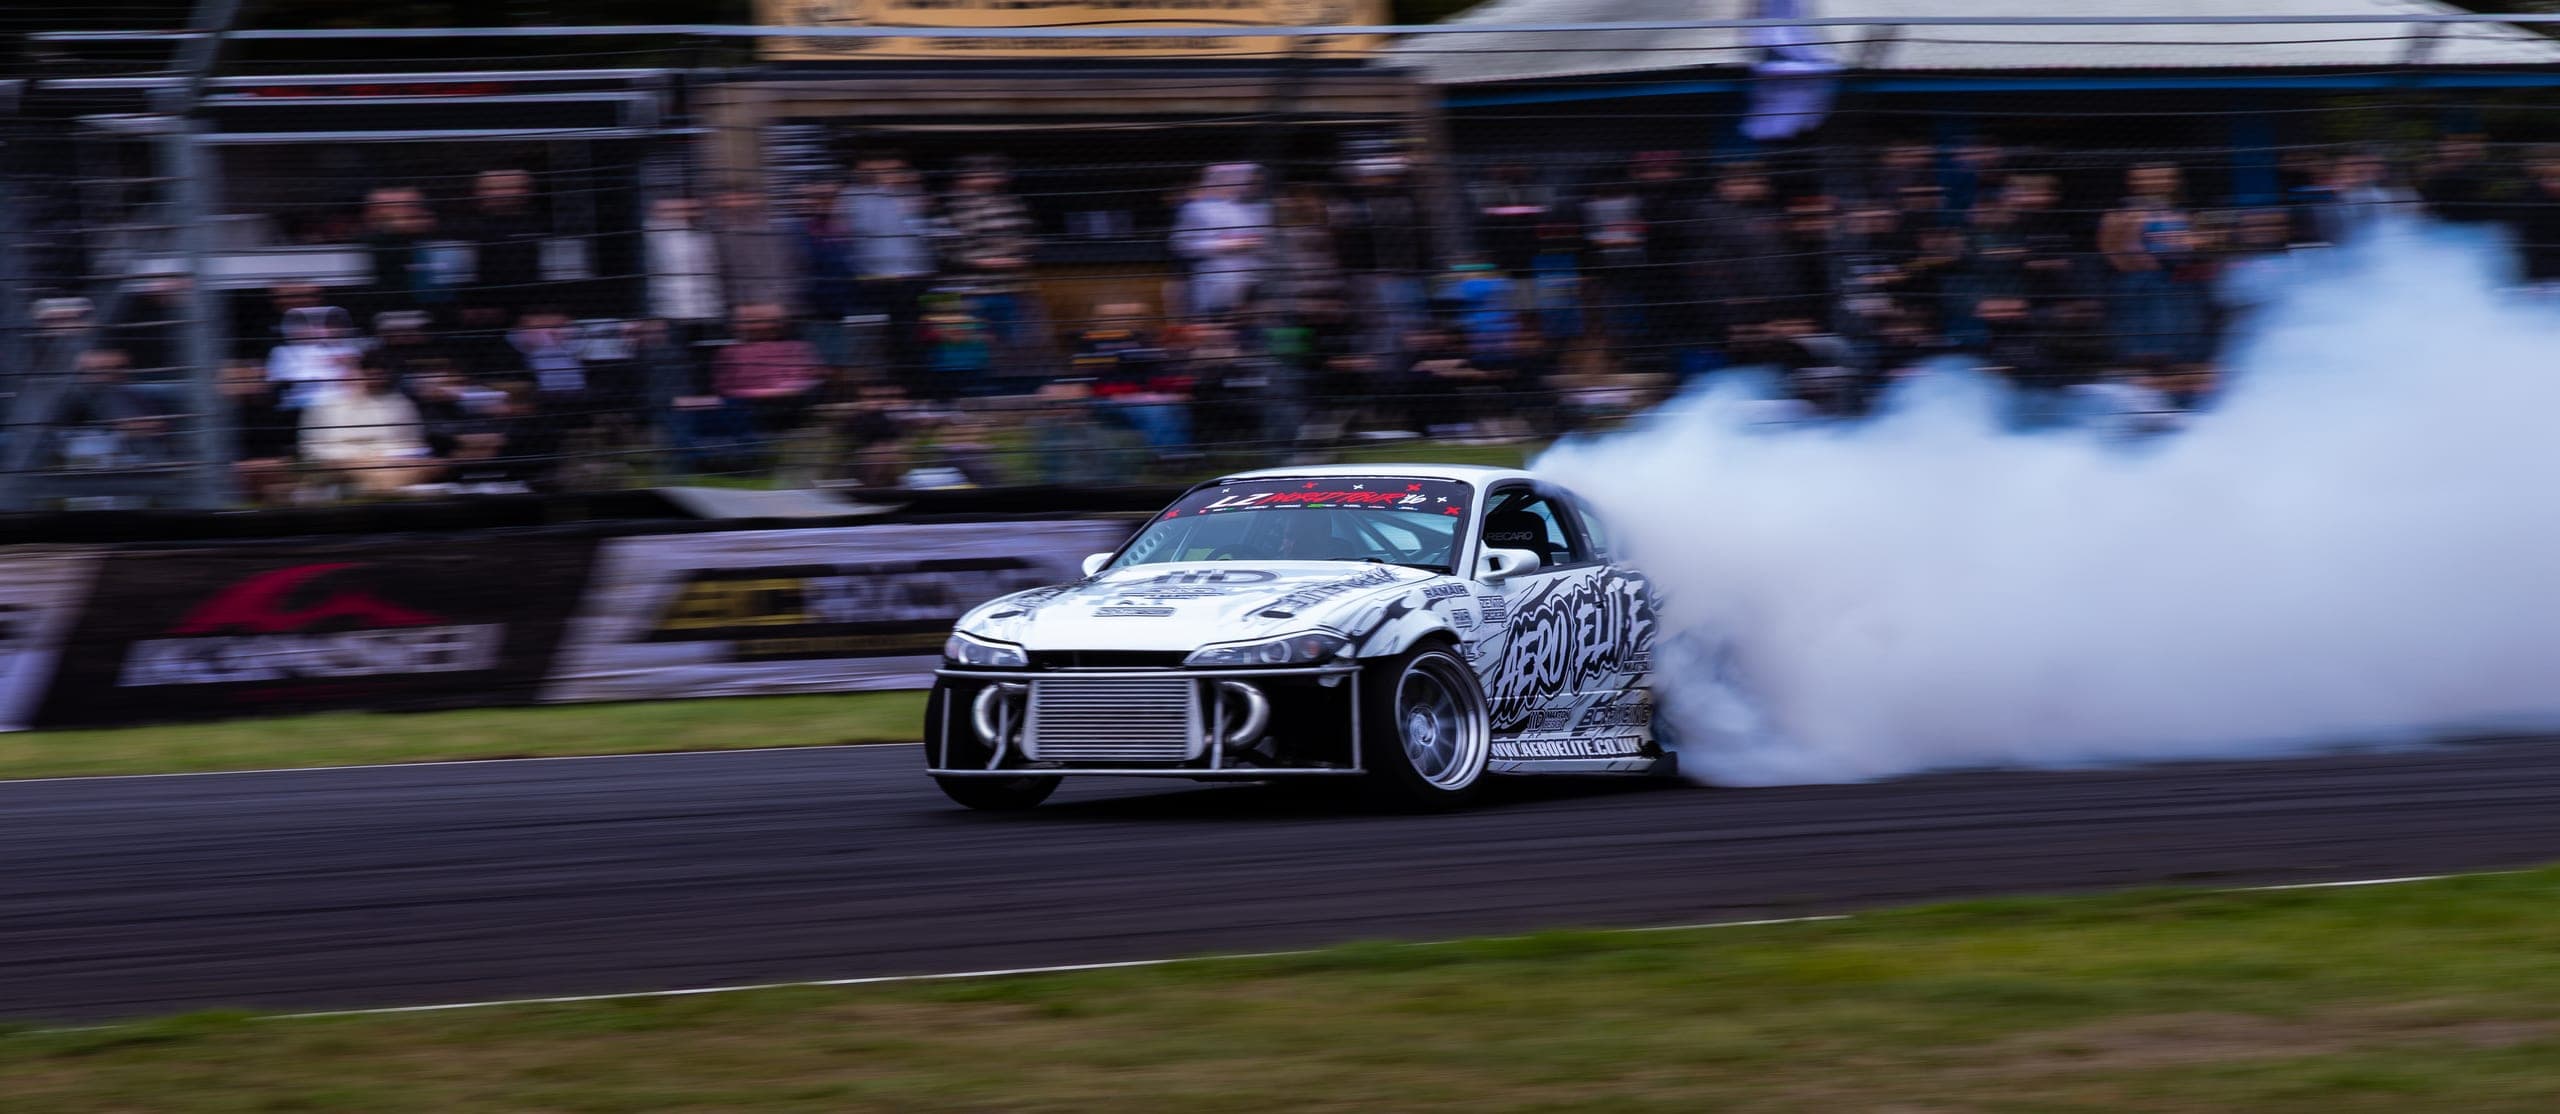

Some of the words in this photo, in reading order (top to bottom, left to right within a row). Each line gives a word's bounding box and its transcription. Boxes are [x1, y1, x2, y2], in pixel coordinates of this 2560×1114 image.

[1486, 531, 1534, 542] RECARO
[1423, 584, 1470, 598] RAMAIR
[1492, 605, 1569, 718] AERO
[1571, 573, 1654, 688] ELITE
